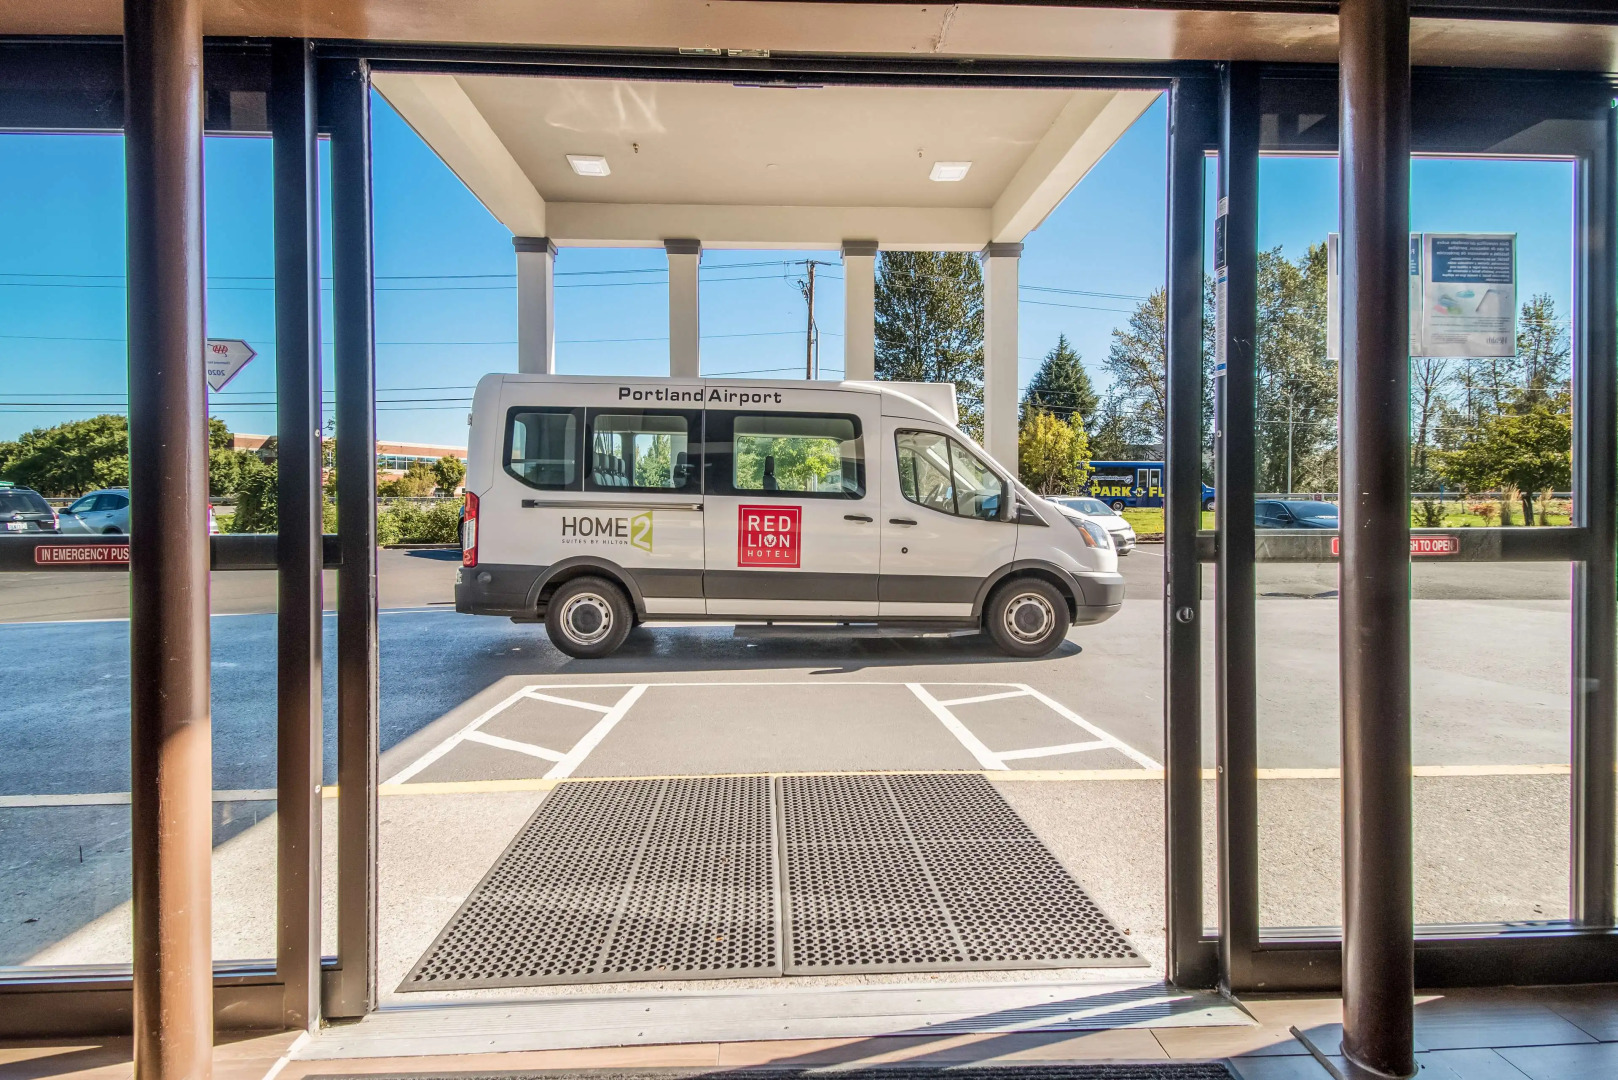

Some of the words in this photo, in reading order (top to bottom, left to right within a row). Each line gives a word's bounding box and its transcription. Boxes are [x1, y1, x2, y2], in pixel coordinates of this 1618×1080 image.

[618, 387, 704, 402] Portland
[708, 389, 782, 406] Airport
[1090, 486, 1132, 497] PARK
[1149, 487, 1165, 497] FL
[562, 516, 628, 538] HOME
[748, 515, 791, 532] RED
[747, 533, 790, 548] LION
[1419, 540, 1430, 551] TO
[1432, 540, 1454, 551] OPEN
[41, 548, 51, 561] IN
[52, 548, 109, 561] EMERGENCY
[111, 547, 129, 560] PUS
[747, 549, 790, 558] HOTEL
